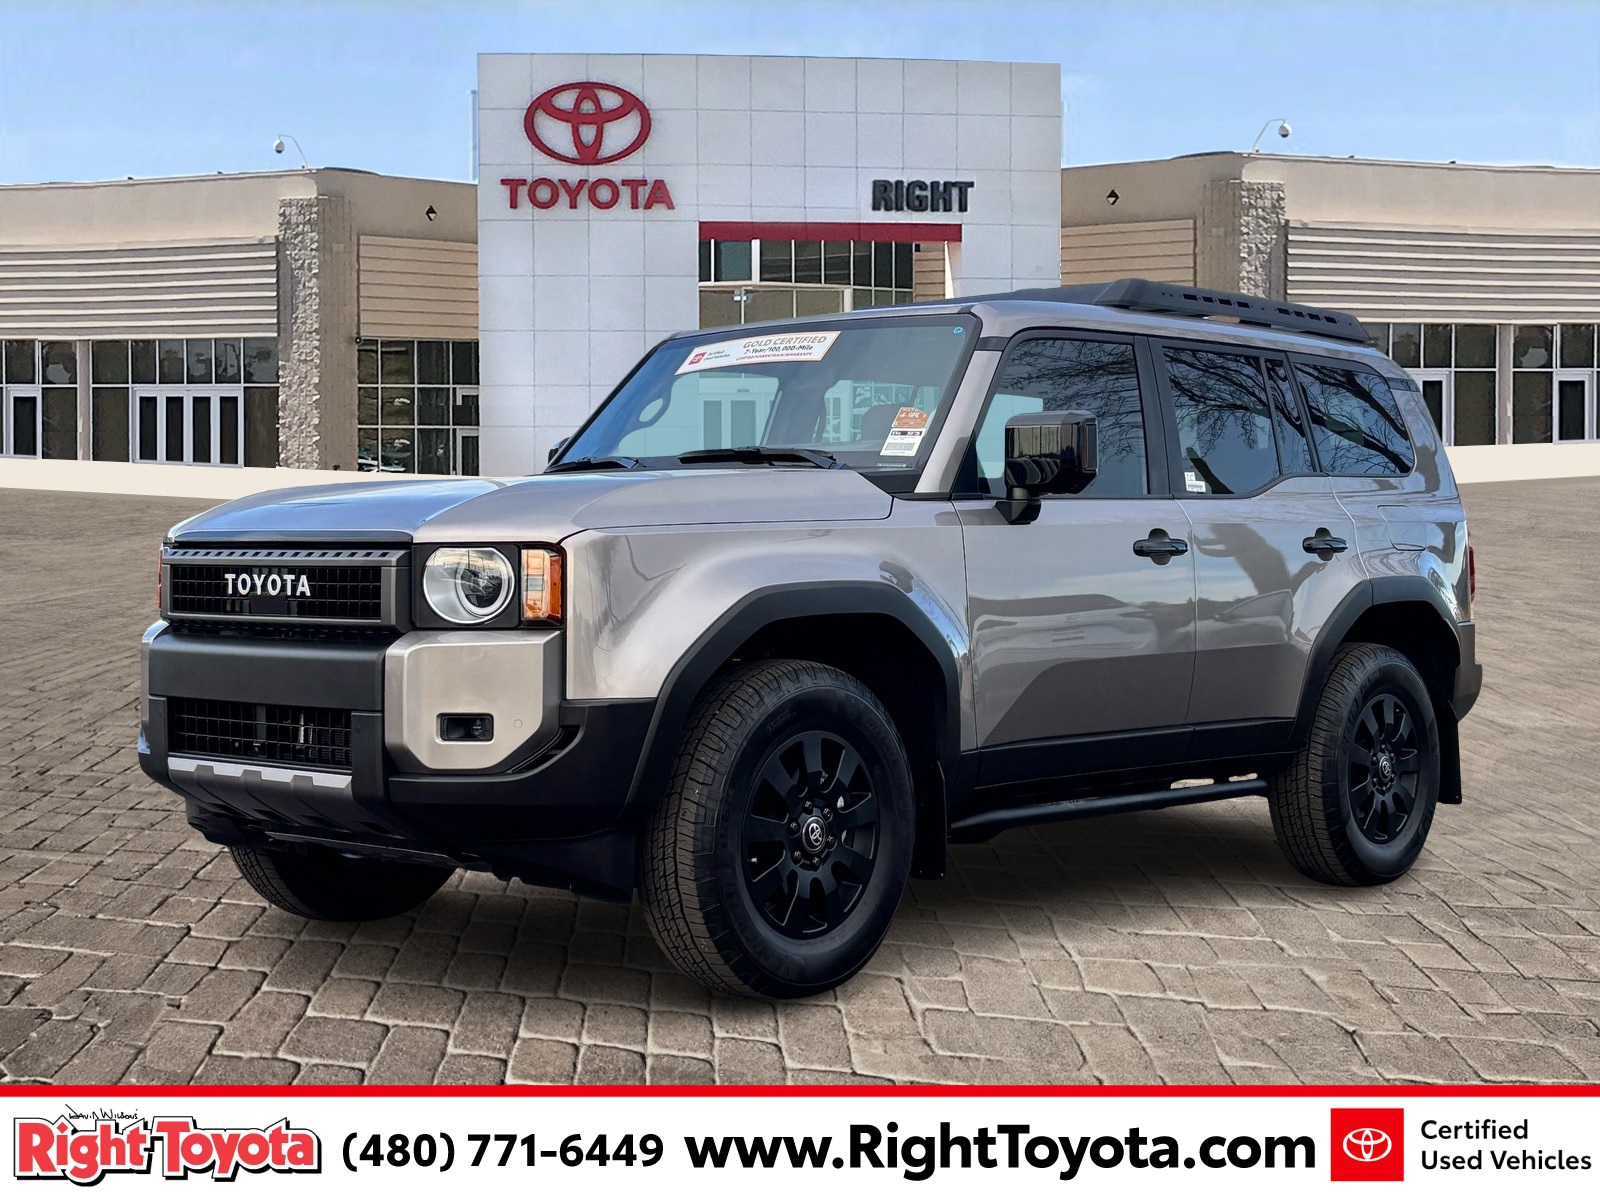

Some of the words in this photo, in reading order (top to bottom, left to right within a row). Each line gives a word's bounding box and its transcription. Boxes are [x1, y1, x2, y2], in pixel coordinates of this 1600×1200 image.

[501, 178, 673, 210] TOYOTA
[871, 179, 975, 213] RIGHT
[743, 339, 773, 349] GOLD
[773, 335, 827, 346] CERTIFIED
[224, 573, 311, 597] TOYOTA
